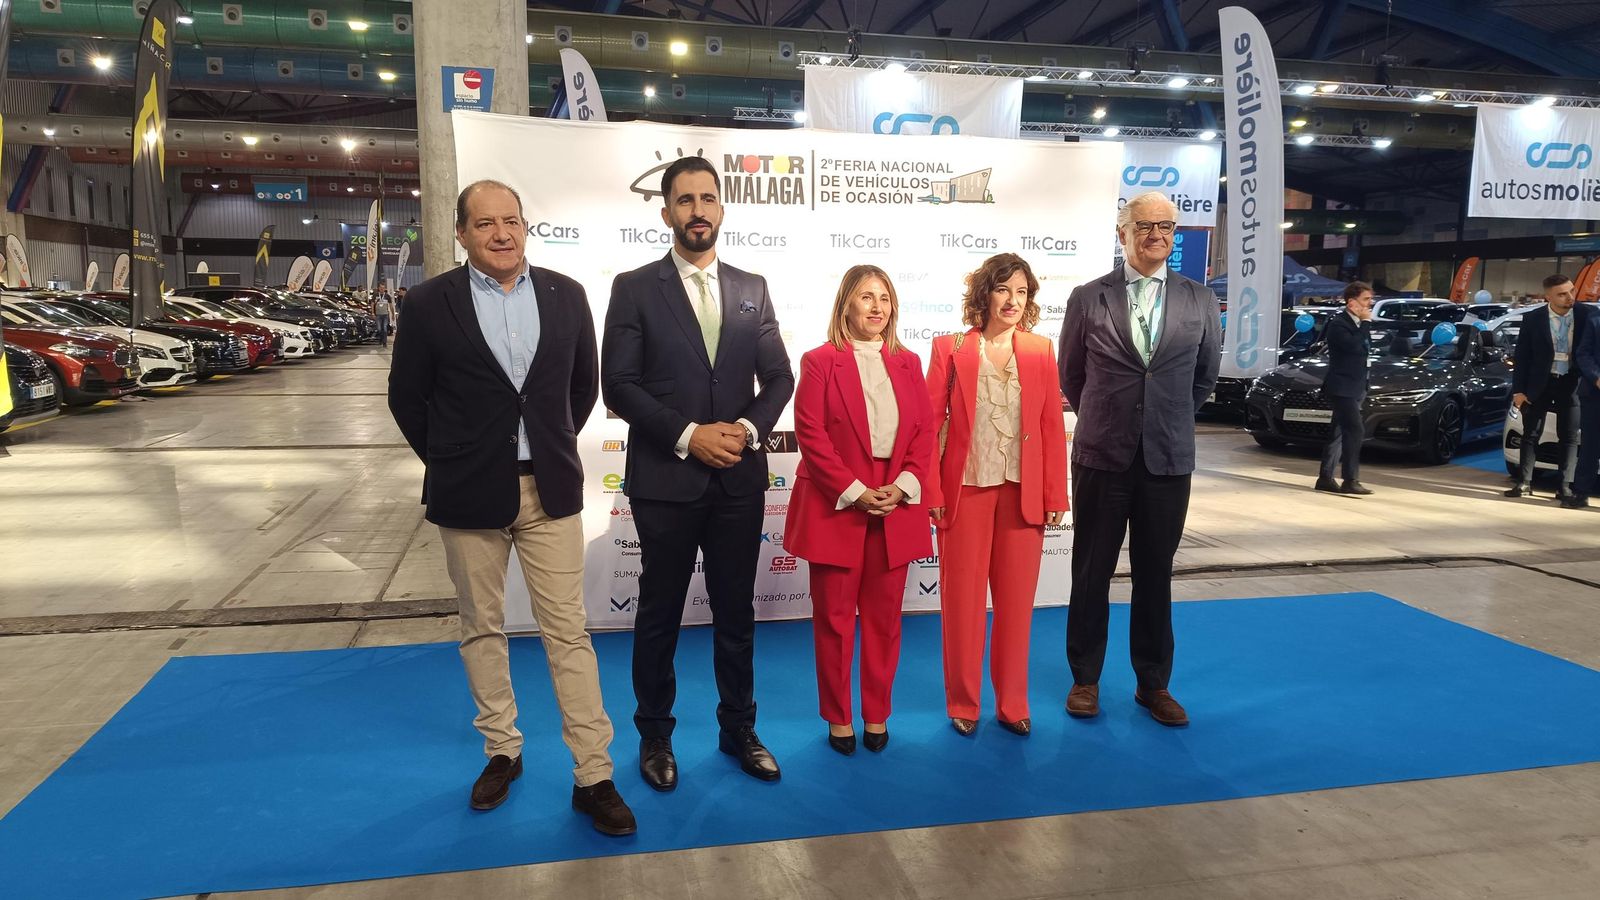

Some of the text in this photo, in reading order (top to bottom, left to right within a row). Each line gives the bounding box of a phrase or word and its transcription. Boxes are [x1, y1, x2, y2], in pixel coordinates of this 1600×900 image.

[724, 154, 804, 174] MOTOR
[881, 161, 953, 174] NACIONAL
[724, 174, 804, 205] MÁLAGA
[820, 175, 930, 189] DE VEHÍCULOS
[820, 189, 913, 204] DE OCASIÓN
[1481, 178, 1600, 202] autosmoliè
[527, 222, 580, 239] kCars
[724, 231, 786, 247] TikCars
[830, 234, 891, 249] TikCars
[940, 233, 998, 249] TikCars
[1020, 236, 1077, 251] TikCars
[772, 556, 796, 566] GS
[789, 592, 805, 603] por
